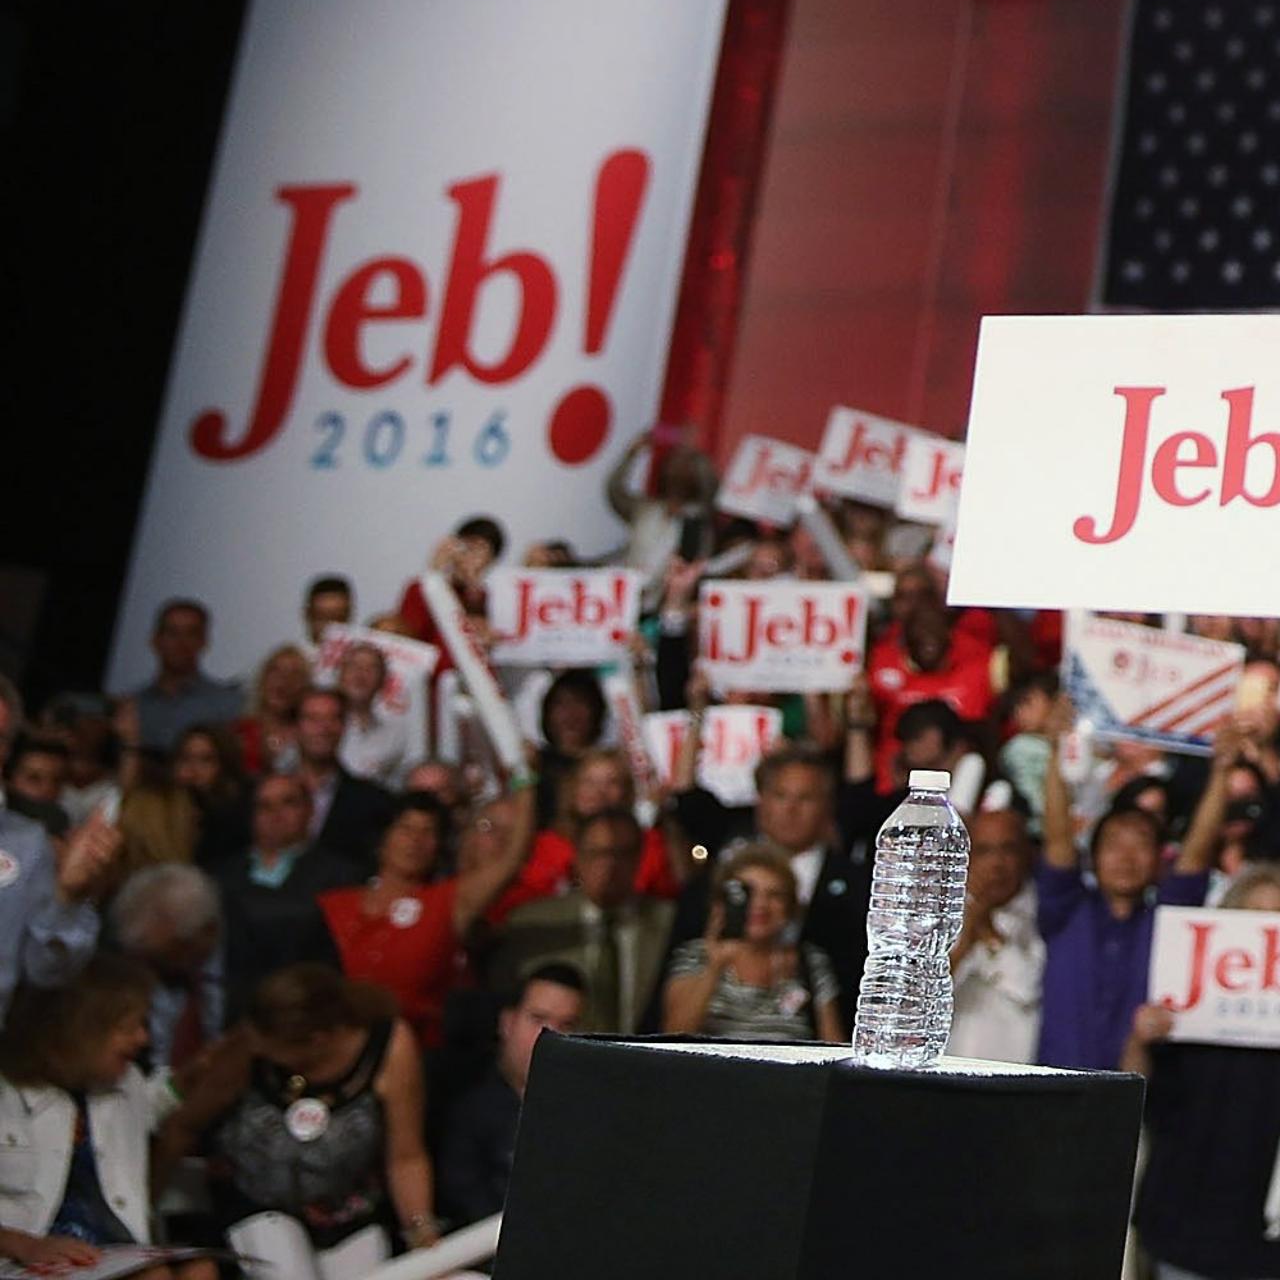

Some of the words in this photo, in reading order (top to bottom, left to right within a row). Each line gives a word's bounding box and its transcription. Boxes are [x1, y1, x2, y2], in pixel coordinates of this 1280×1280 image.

[189, 146, 652, 466] Jeb!
[310, 410, 512, 472] 2016
[493, 577, 628, 645] Jeb!
[708, 590, 858, 665] ¡Jeb!
